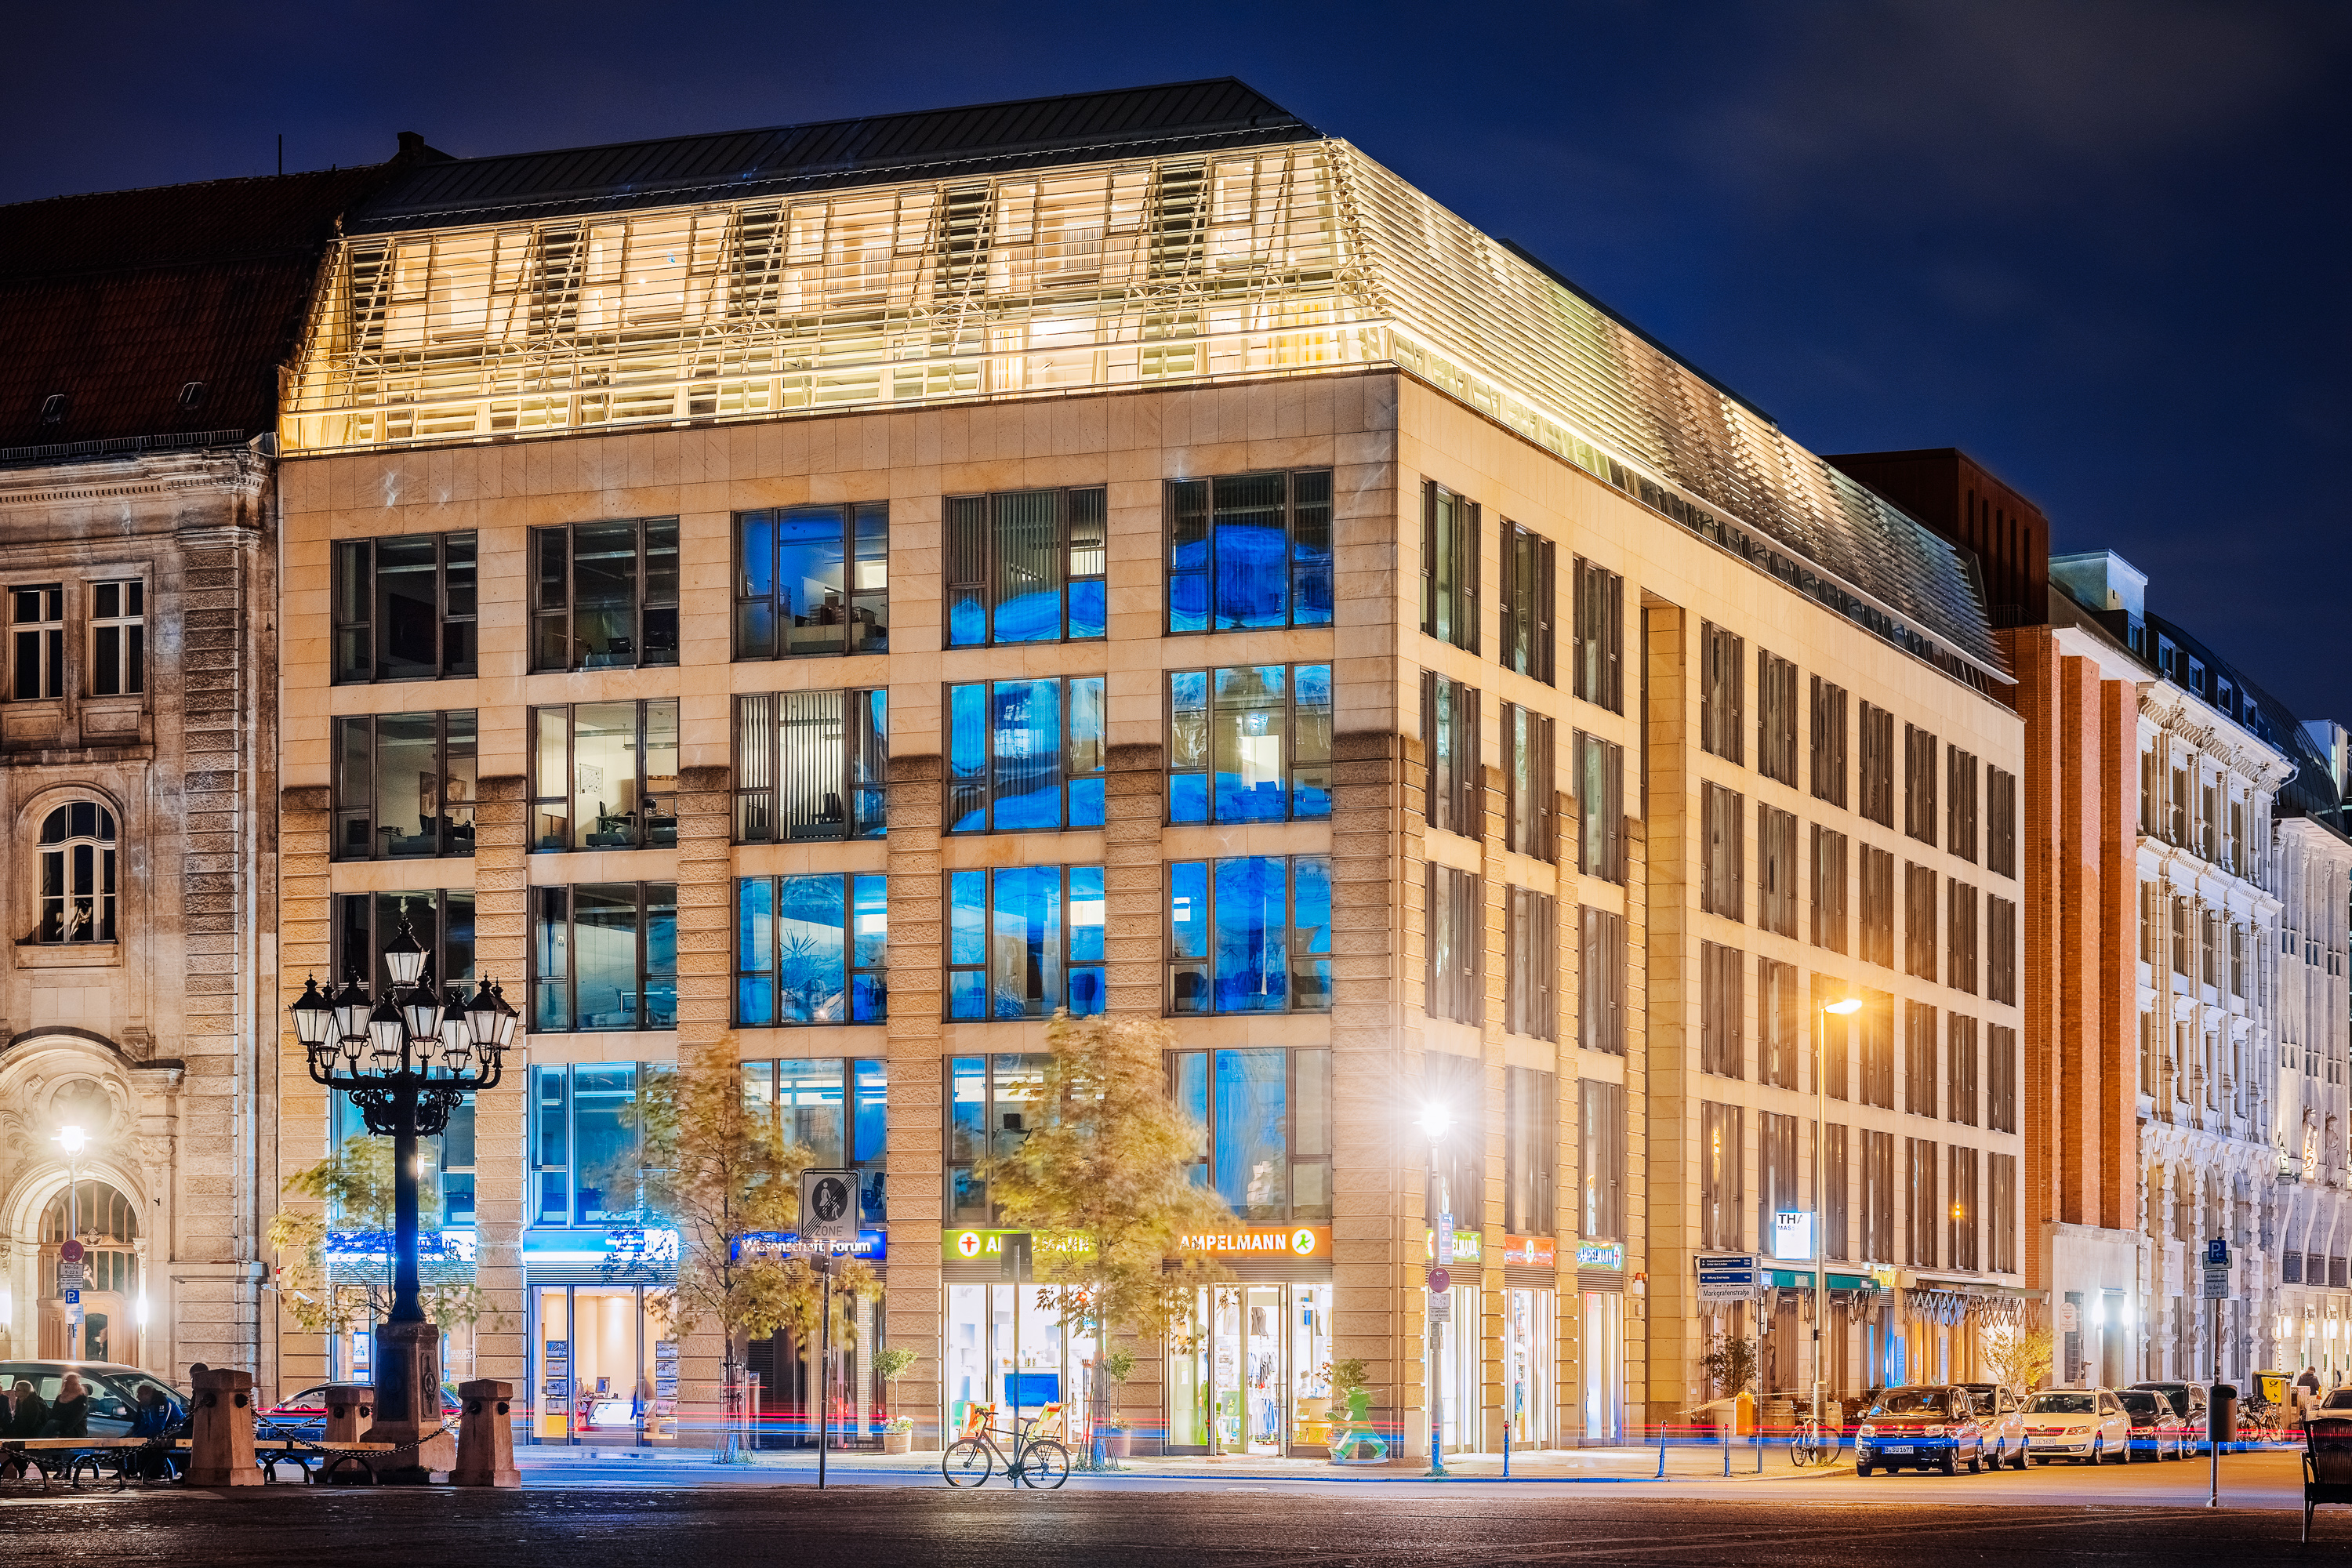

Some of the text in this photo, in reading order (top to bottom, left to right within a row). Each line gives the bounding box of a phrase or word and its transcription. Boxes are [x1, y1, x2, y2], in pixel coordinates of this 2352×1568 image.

[815, 1225, 843, 1236] ZONE
[829, 1240, 871, 1252] Forum
[1178, 1234, 1287, 1250] AMPELMANN
[2211, 1242, 2221, 1258] P
[67, 1292, 75, 1302] P
[1703, 1288, 1750, 1298] Markgrafenstraße
